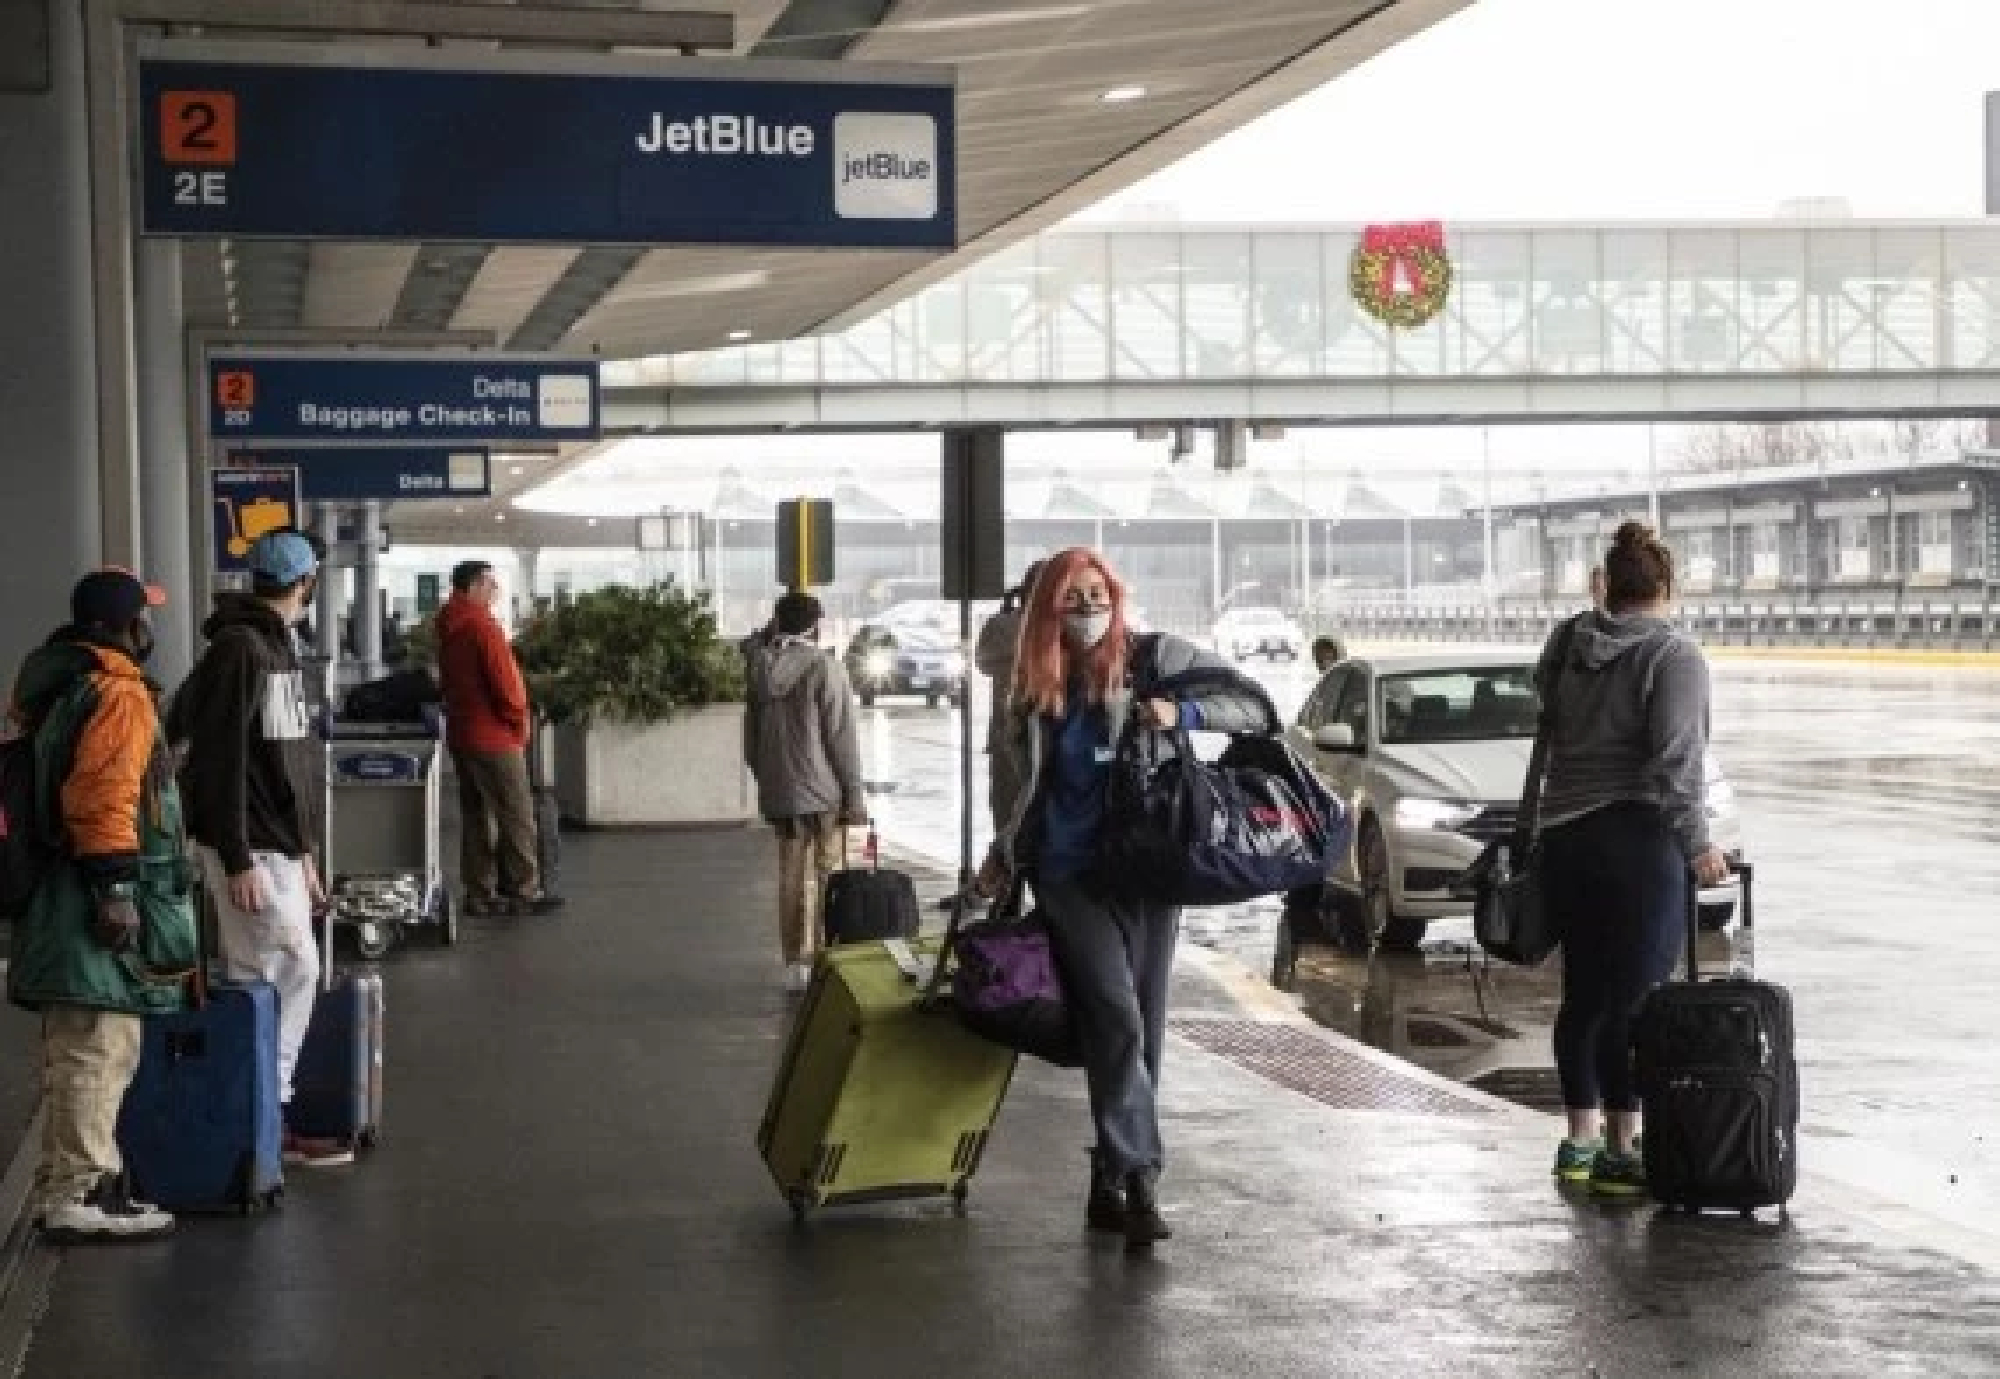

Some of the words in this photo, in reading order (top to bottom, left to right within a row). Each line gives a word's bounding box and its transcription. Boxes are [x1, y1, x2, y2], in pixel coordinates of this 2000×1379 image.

[181, 102, 218, 149] 2
[636, 112, 814, 154] JetBlue
[842, 152, 931, 186] jetBlue
[174, 171, 226, 205] 2E
[227, 376, 247, 401] 2
[473, 377, 530, 398] Delta
[299, 403, 411, 428] Baggage
[418, 403, 530, 426] Check-In
